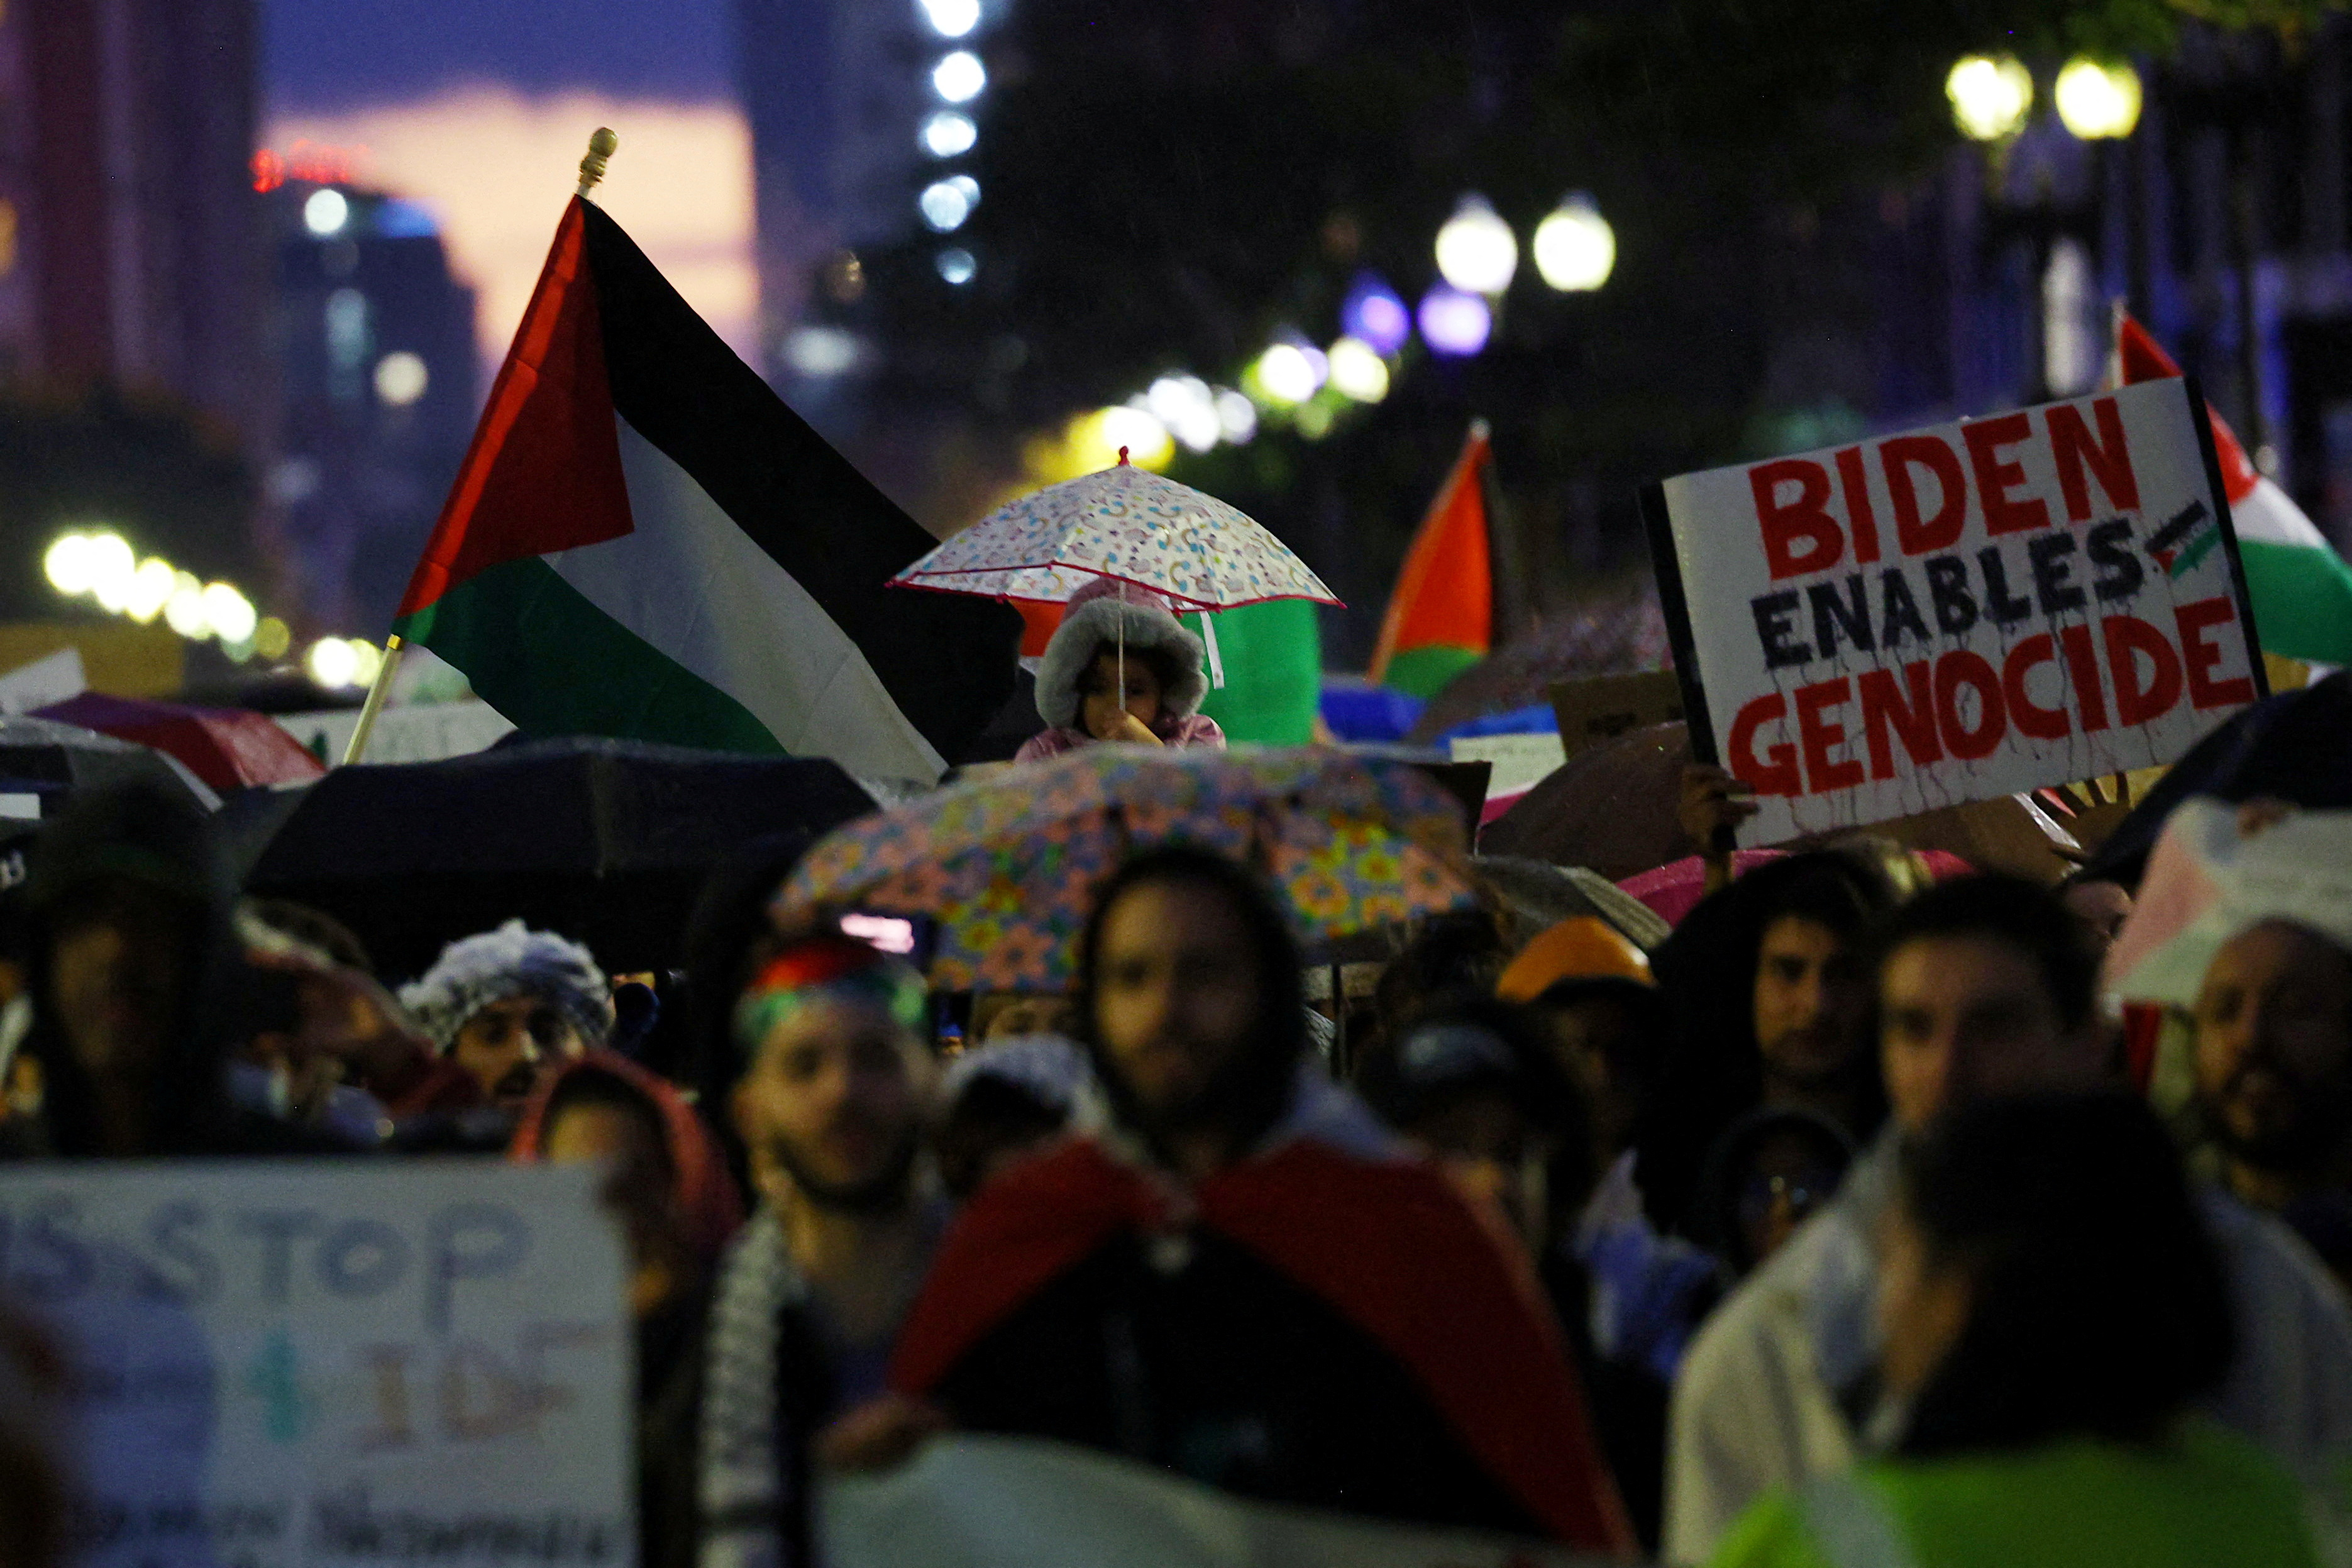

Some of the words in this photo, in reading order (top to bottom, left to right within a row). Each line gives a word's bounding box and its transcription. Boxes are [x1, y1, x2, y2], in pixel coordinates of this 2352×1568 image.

[1749, 397, 2140, 580] BIDEN
[1751, 518, 2144, 669] ENABLES
[1728, 597, 2258, 796] GENOCIDE
[0, 1192, 97, 1303] S
[133, 1198, 534, 1335] STOP
